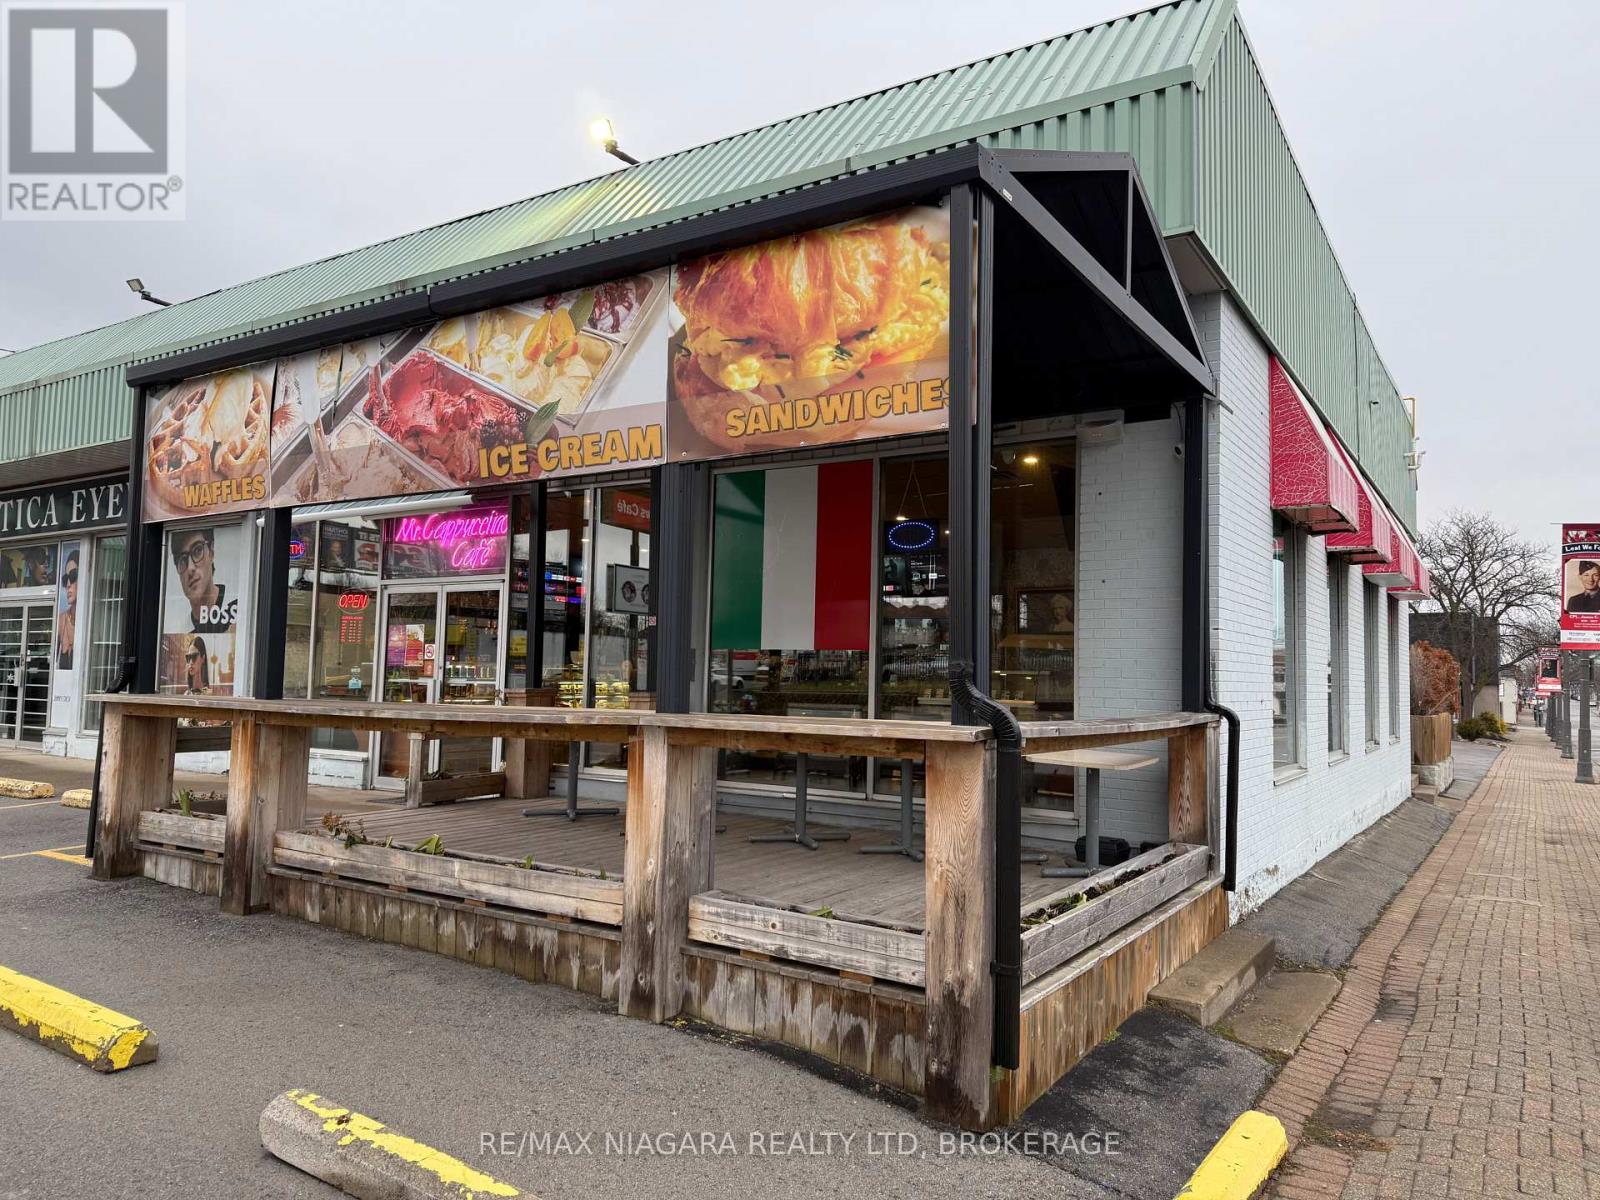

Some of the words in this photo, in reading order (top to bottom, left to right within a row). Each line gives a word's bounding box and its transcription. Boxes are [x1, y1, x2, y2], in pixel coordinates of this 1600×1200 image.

[478, 440, 529, 479] ICE
[536, 424, 663, 473] CREAM
[70, 482, 130, 524] EYE
[183, 474, 266, 508] WAFFLES
[290, 543, 303, 554] TM
[199, 604, 239, 625] BOSS
[338, 594, 369, 609] OPEN
